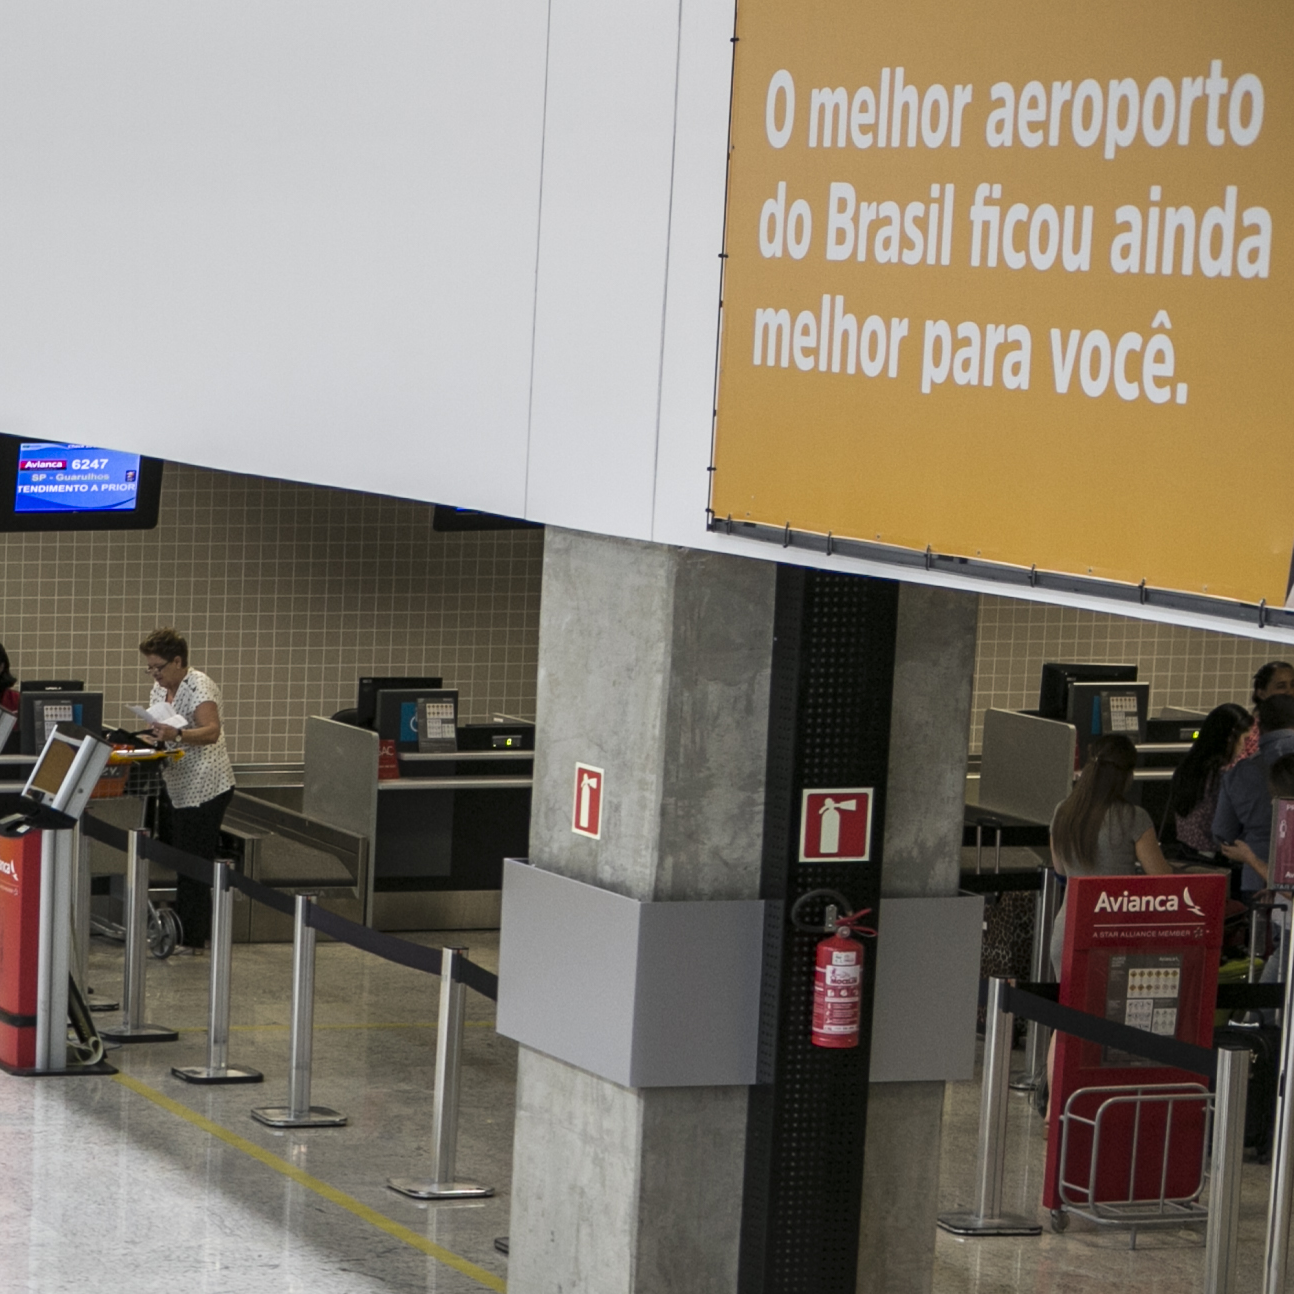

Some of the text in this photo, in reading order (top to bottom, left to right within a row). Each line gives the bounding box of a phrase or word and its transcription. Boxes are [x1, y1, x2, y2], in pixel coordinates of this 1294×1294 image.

[765, 59, 1265, 160] O melhor aeroporto
[759, 181, 1273, 279] do Brasil ficou ainda
[753, 294, 1189, 404] melhor para você.
[24, 458, 109, 470] Avianca 6247
[31, 473, 47, 482] SP
[55, 473, 110, 482] Guarulhos
[18, 483, 136, 493] TENDIMENTO A PRIOR
[1093, 890, 1179, 913] Avianca
[1099, 930, 1119, 938] STAR
[1120, 930, 1157, 938] ALLIANCE
[1158, 929, 1191, 937] MEMBER
